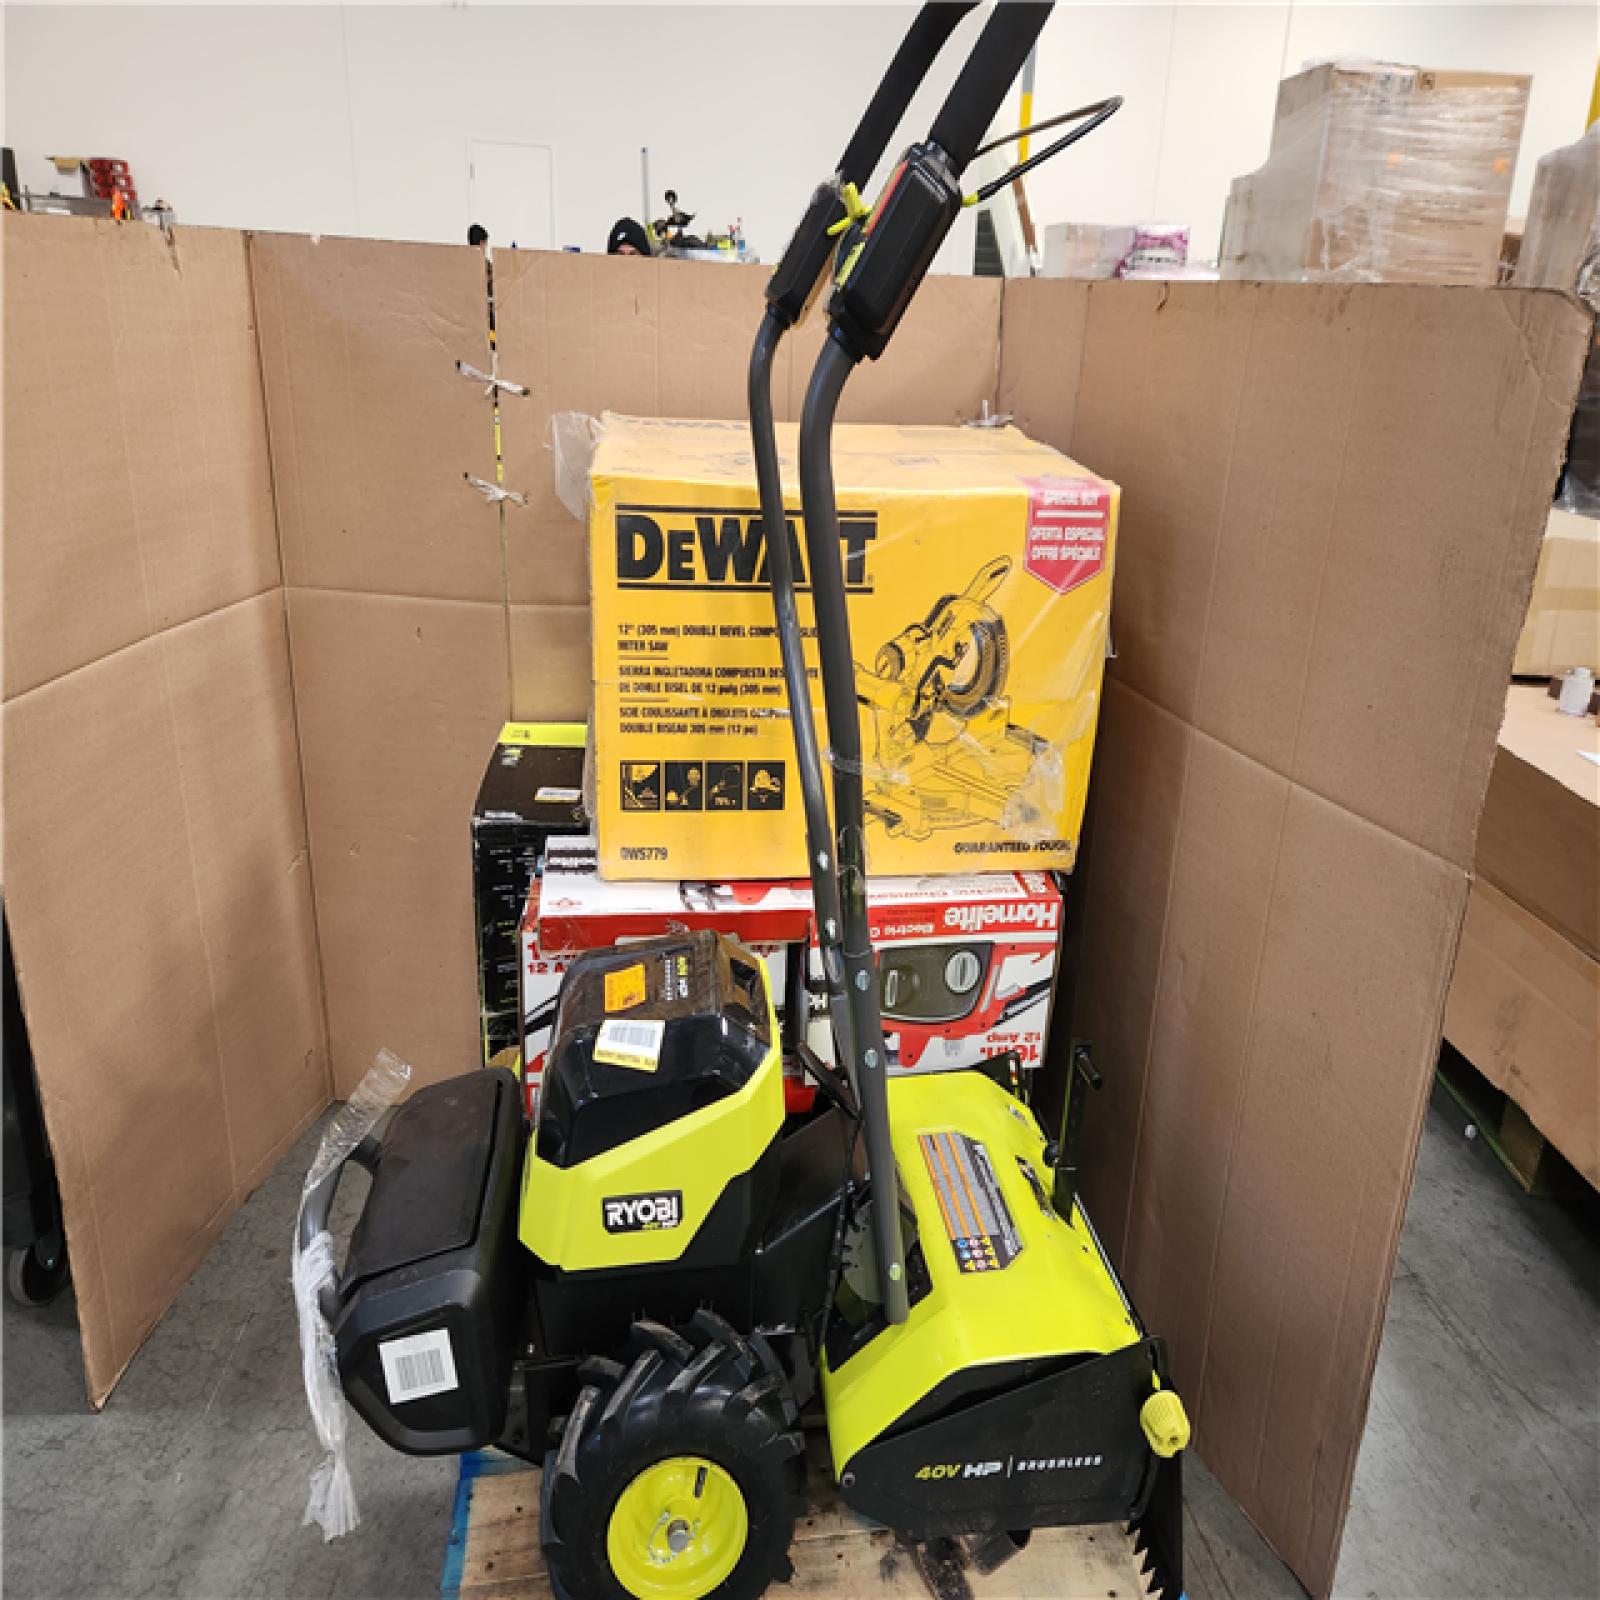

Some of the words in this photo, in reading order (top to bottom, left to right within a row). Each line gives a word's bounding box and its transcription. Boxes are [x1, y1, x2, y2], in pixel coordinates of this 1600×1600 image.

[682, 625, 716, 637] DOUBLE
[719, 625, 745, 637] BEVEL
[648, 640, 668, 651] SAW
[618, 665, 651, 677] SIERRA
[691, 682, 703, 694] DE
[619, 722, 653, 734] DOUBLE
[656, 722, 688, 734] BISEAU
[954, 841, 1031, 854] GUARANTEED
[944, 902, 1059, 931] Homelite
[986, 1031, 1019, 1044] Amp
[1024, 1031, 1041, 1044] 12
[605, 1196, 678, 1226] RYOBI
[914, 1463, 962, 1480] 40V
[962, 1461, 1003, 1479] HP
